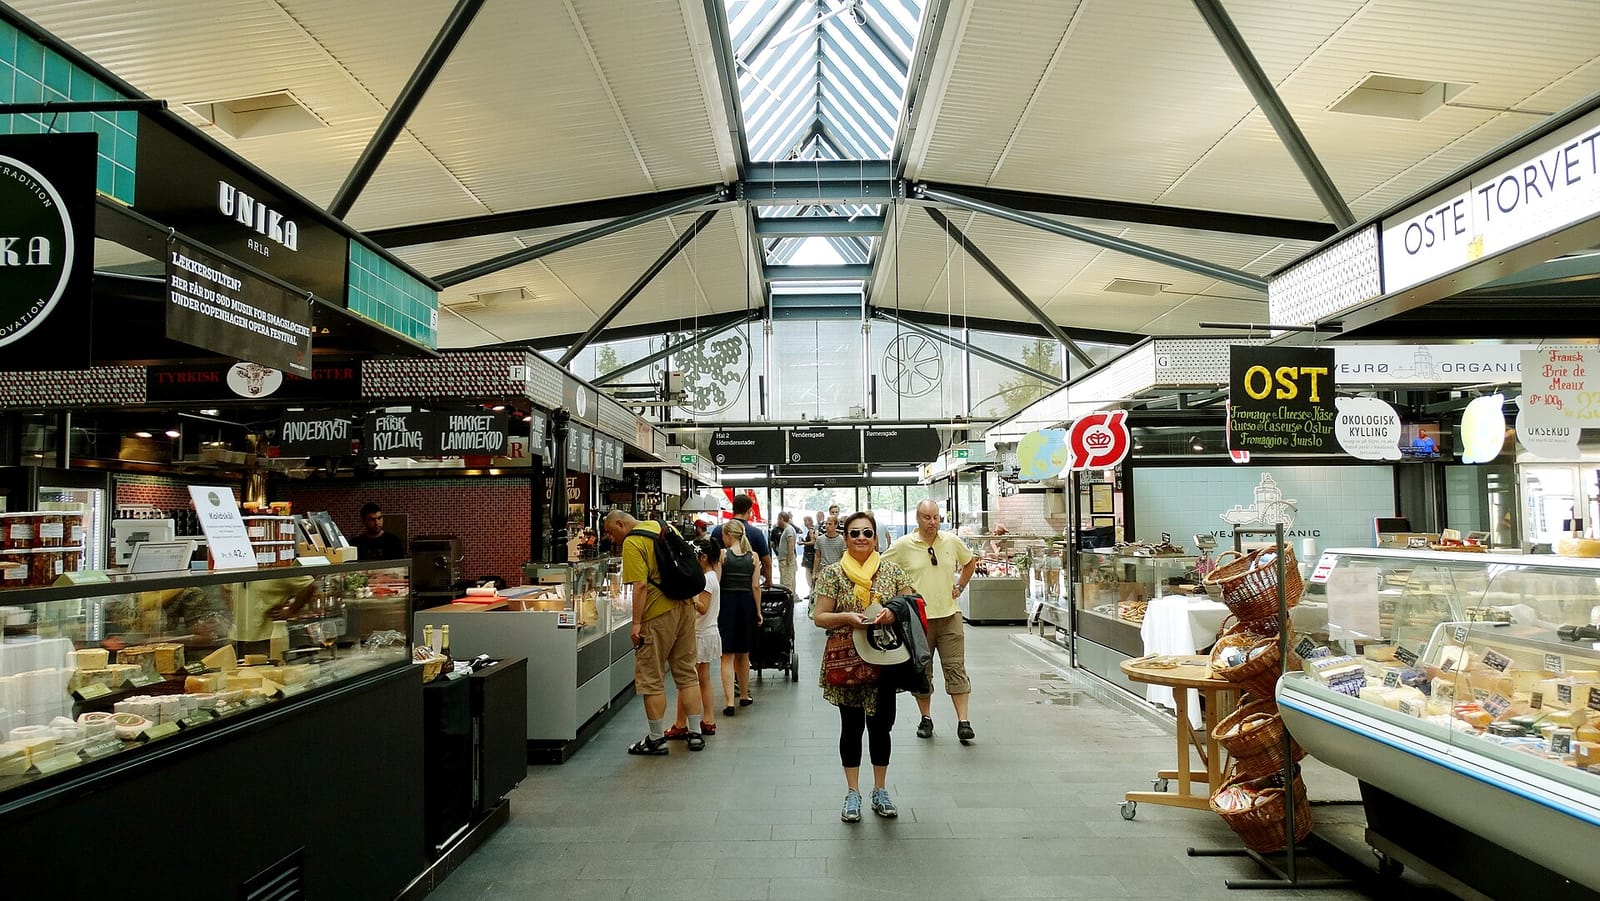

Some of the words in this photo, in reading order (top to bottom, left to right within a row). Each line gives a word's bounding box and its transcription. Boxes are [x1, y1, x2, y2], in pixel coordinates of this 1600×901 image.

[217, 180, 298, 252] UNIKA
[1404, 198, 1466, 255] OSTE
[247, 238, 270, 257] ARLA
[172, 251, 242, 292] LÆKKERSULTEN?
[171, 275, 188, 293] HER
[189, 281, 204, 298] FÅR
[204, 288, 216, 302] DU
[216, 293, 231, 308] SØD
[231, 298, 253, 317] MUSIK
[253, 308, 267, 321] FOR
[171, 291, 200, 312] UNDER
[200, 302, 249, 329] COPENHAGEN
[248, 320, 271, 336] OPERA
[271, 327, 298, 346] FESTIVAL
[1158, 356, 1168, 367] G
[1549, 350, 1584, 363] Fransk
[158, 369, 220, 384] TYRKISK
[514, 367, 522, 378] F
[1542, 364, 1568, 378] Brie
[1573, 364, 1586, 377] de
[1244, 365, 1329, 403] OST
[1549, 378, 1584, 391] Meaux
[1230, 405, 1271, 423] Fromage
[1278, 405, 1307, 420] Cheese
[1342, 415, 1395, 425] ØKOLOGISK
[283, 418, 352, 443] ANDEBRYST
[376, 415, 408, 432] FRISK
[450, 415, 496, 432] HAKKET
[1230, 419, 1257, 432] Queso
[1349, 427, 1388, 437] KYLLING
[373, 430, 423, 451] KYLLING
[441, 431, 503, 452] LAMMEKØD
[510, 442, 525, 459] R
